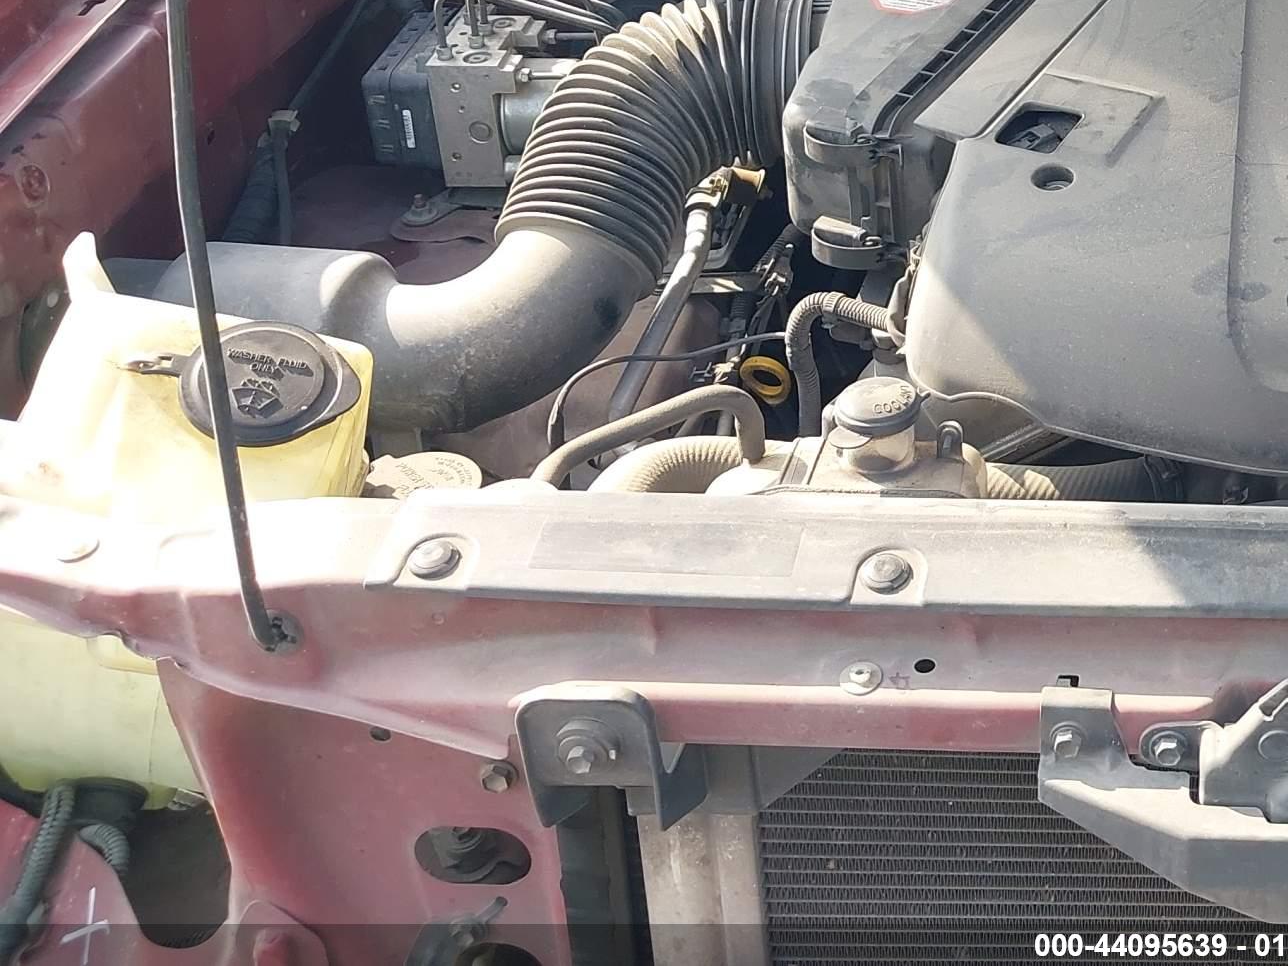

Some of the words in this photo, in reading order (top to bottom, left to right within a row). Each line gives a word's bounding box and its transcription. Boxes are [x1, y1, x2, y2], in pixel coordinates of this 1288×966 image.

[227, 348, 273, 363] WASHER
[277, 357, 308, 369] FLUID
[250, 362, 279, 373] ONLY
